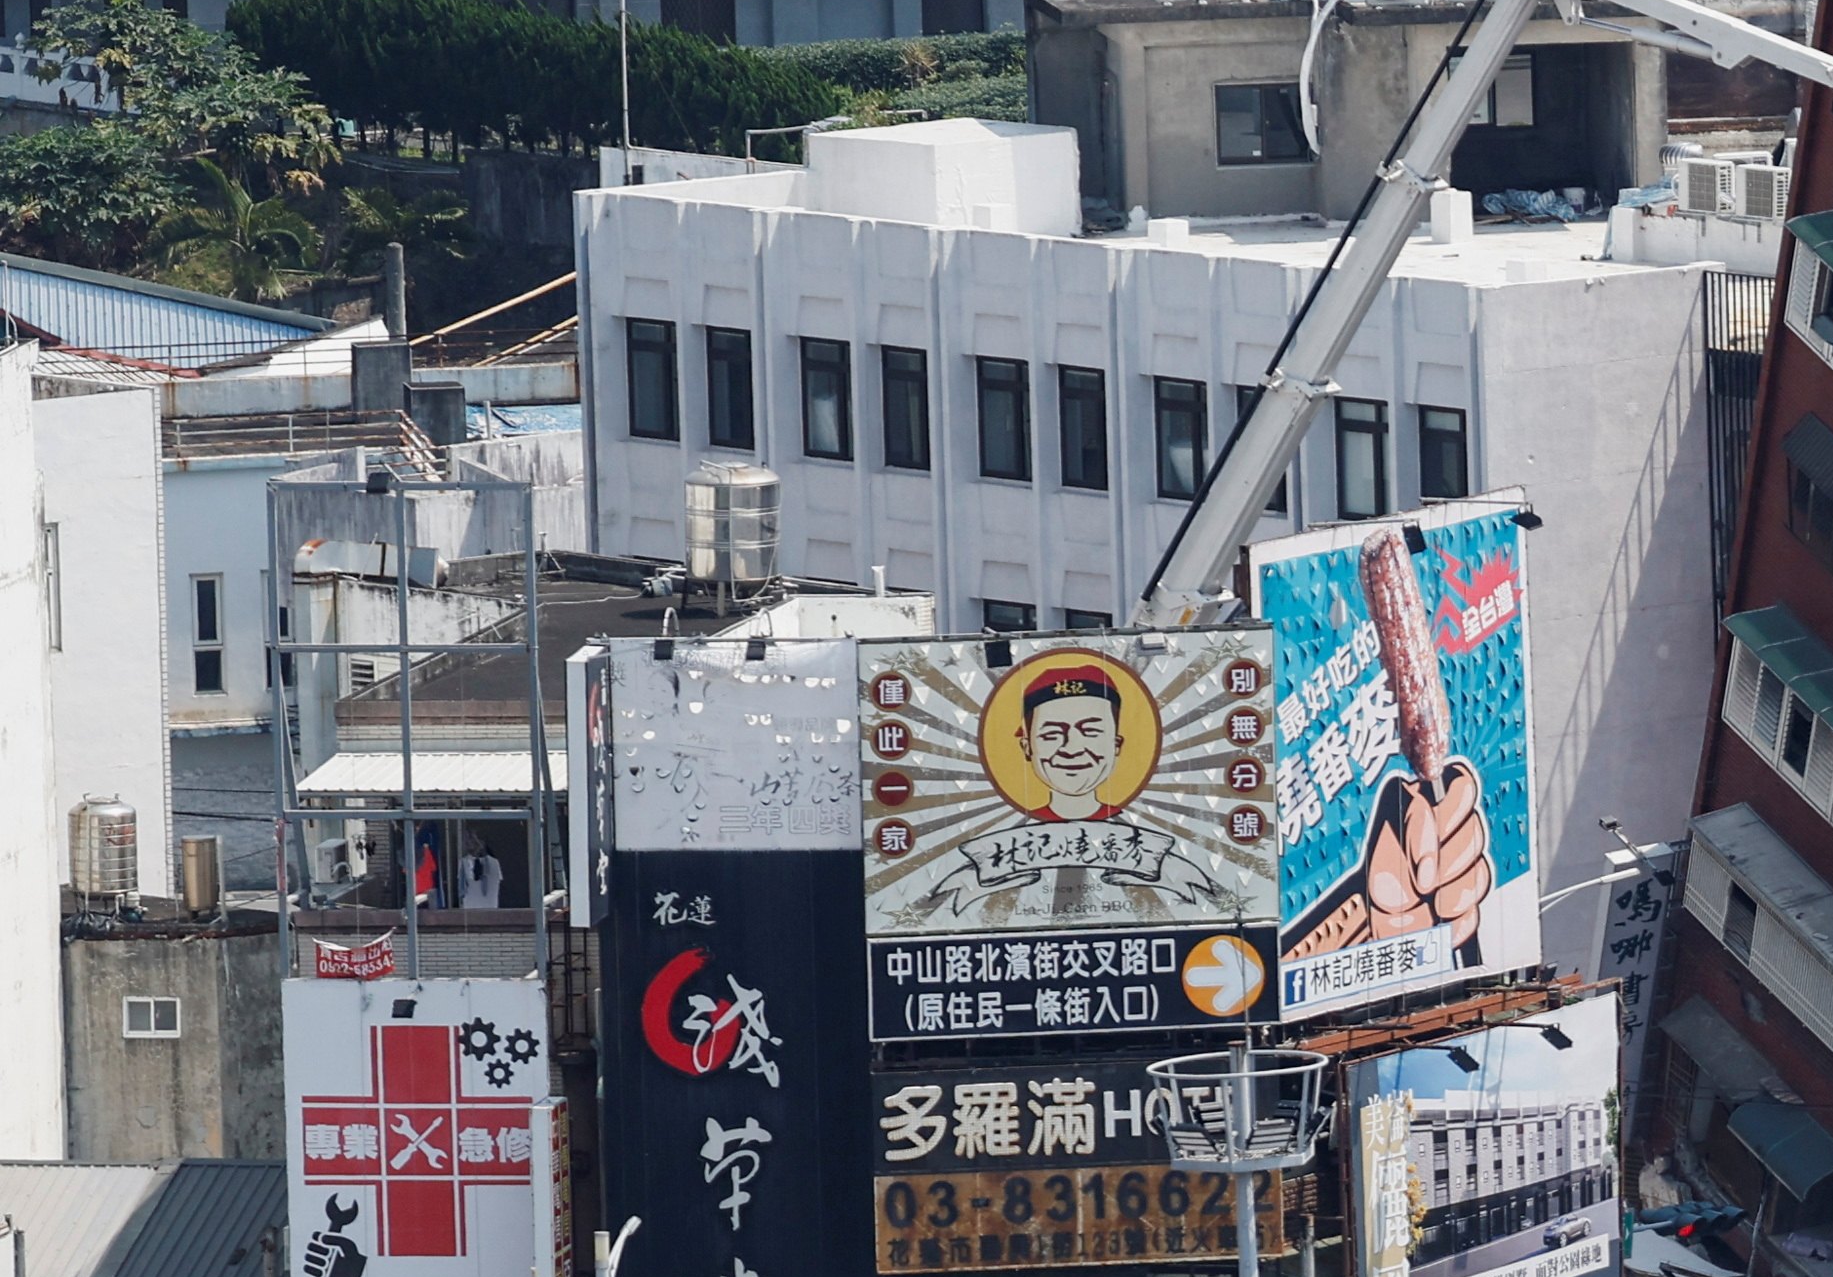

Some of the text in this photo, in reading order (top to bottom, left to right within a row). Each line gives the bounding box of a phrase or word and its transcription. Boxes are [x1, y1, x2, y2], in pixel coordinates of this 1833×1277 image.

[1462, 582, 1515, 643] 全台灣
[1053, 681, 1088, 695] 林記
[1277, 620, 1382, 746] 最好吃的
[877, 679, 908, 851] 僅此一家
[1230, 668, 1260, 838] 別無分號
[989, 827, 1154, 871] 林記燒番麥
[653, 891, 716, 926] 花蓮
[887, 938, 1176, 986] 中山路北濱街交叉路口
[1310, 938, 1417, 995] 林記燒番麥
[904, 983, 1160, 1032] (原住民一條街入口)
[304, 1123, 532, 1163] 專業 急修
[880, 1076, 1096, 1162] 多羅滿
